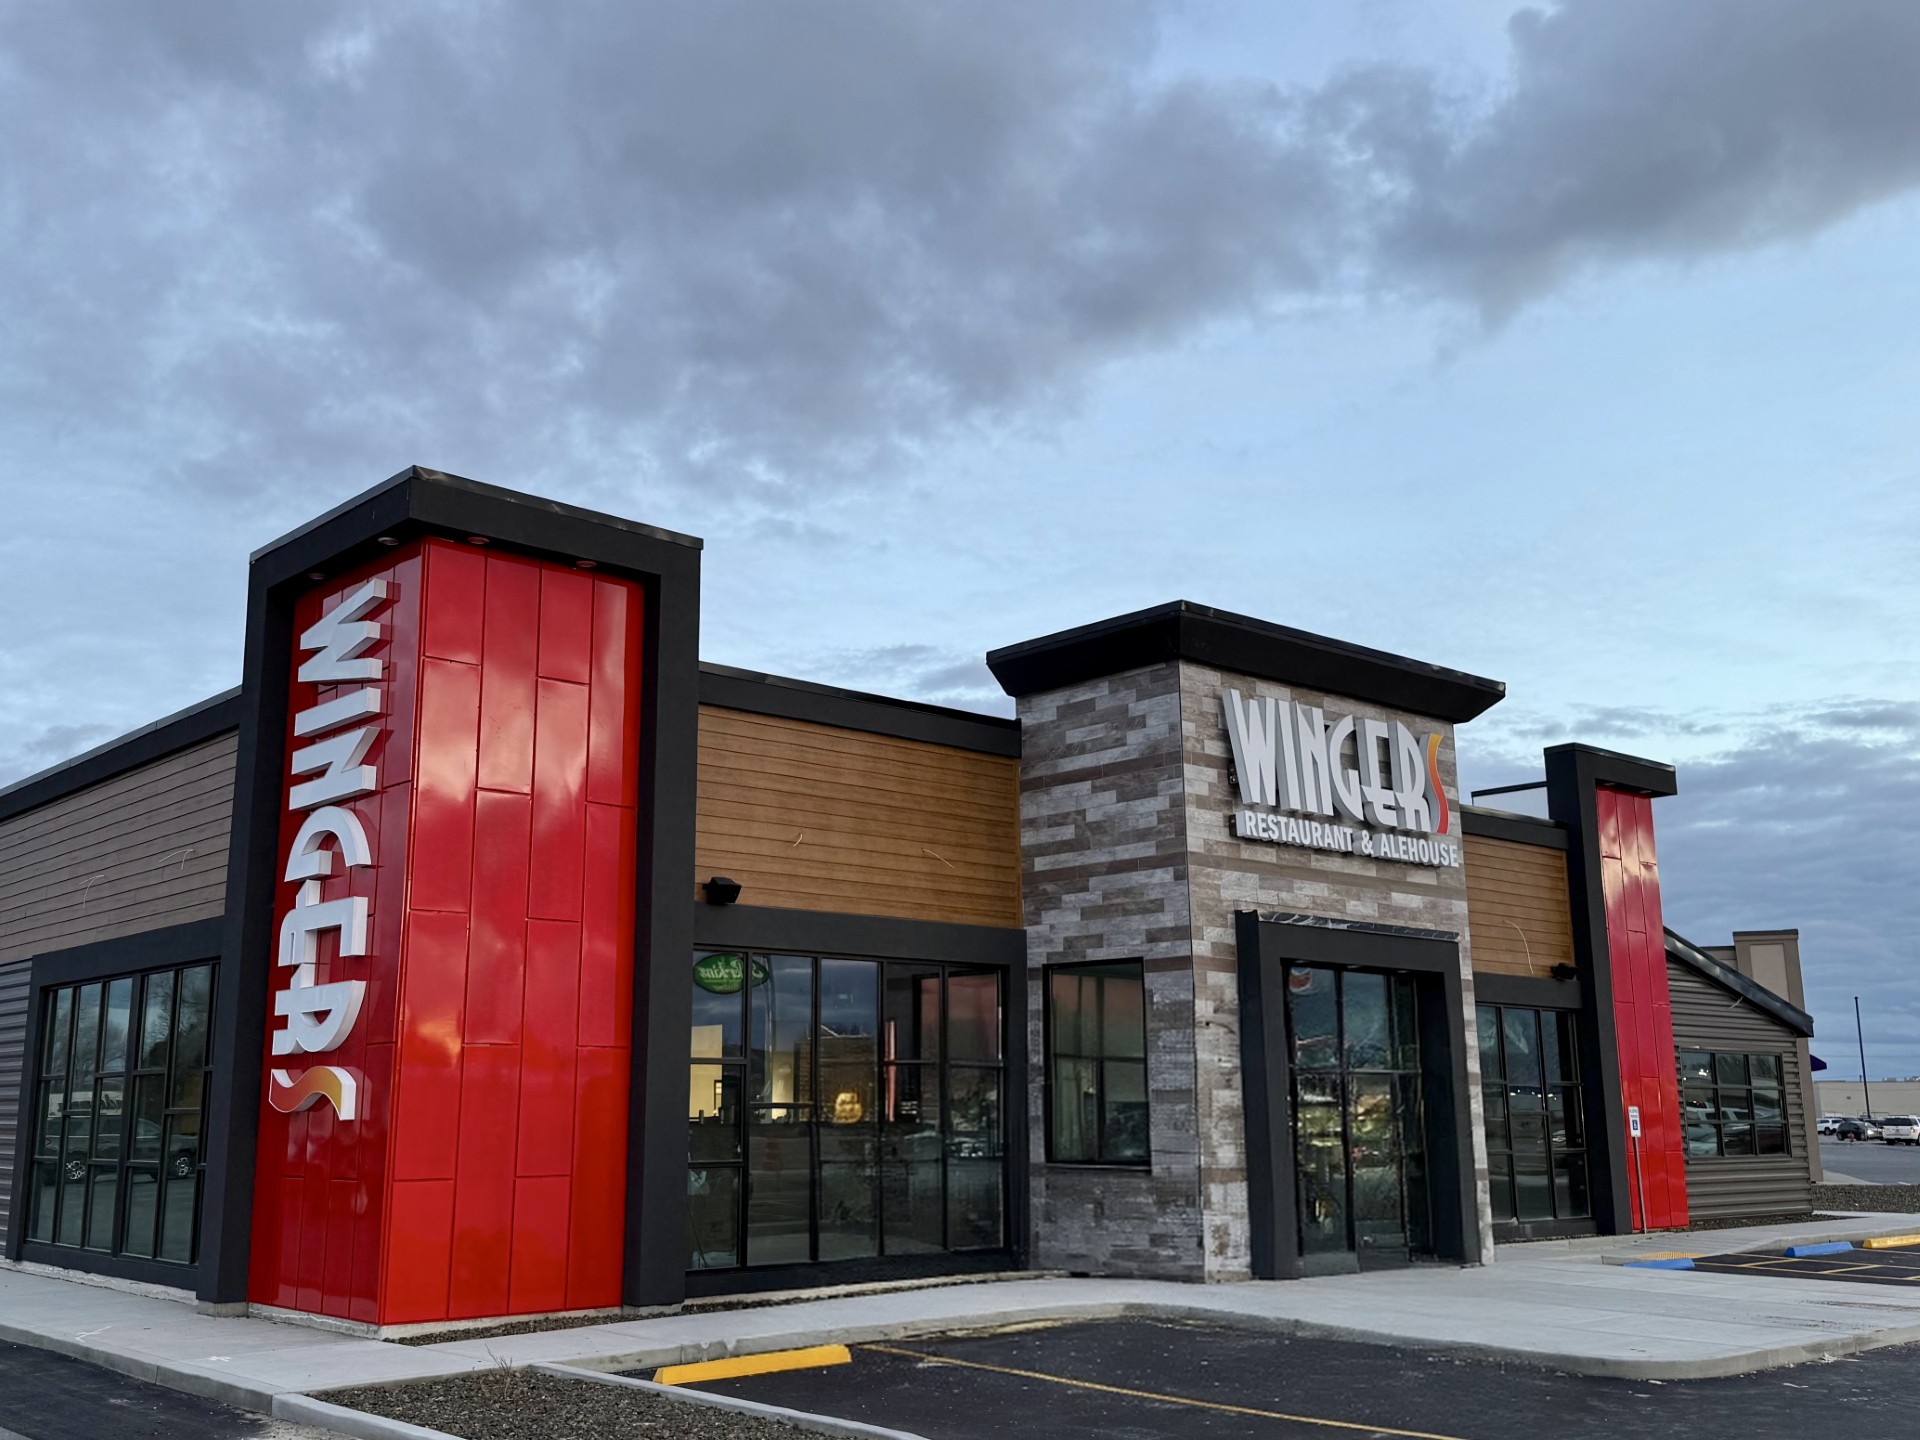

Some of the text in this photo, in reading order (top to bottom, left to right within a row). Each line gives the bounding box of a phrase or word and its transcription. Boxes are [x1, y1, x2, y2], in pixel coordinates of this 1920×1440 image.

[1222, 688, 1449, 835] WINGERS
[269, 578, 390, 1120] WINGERS
[1244, 811, 1459, 868] RESTAURANT & ALEHOUSE
